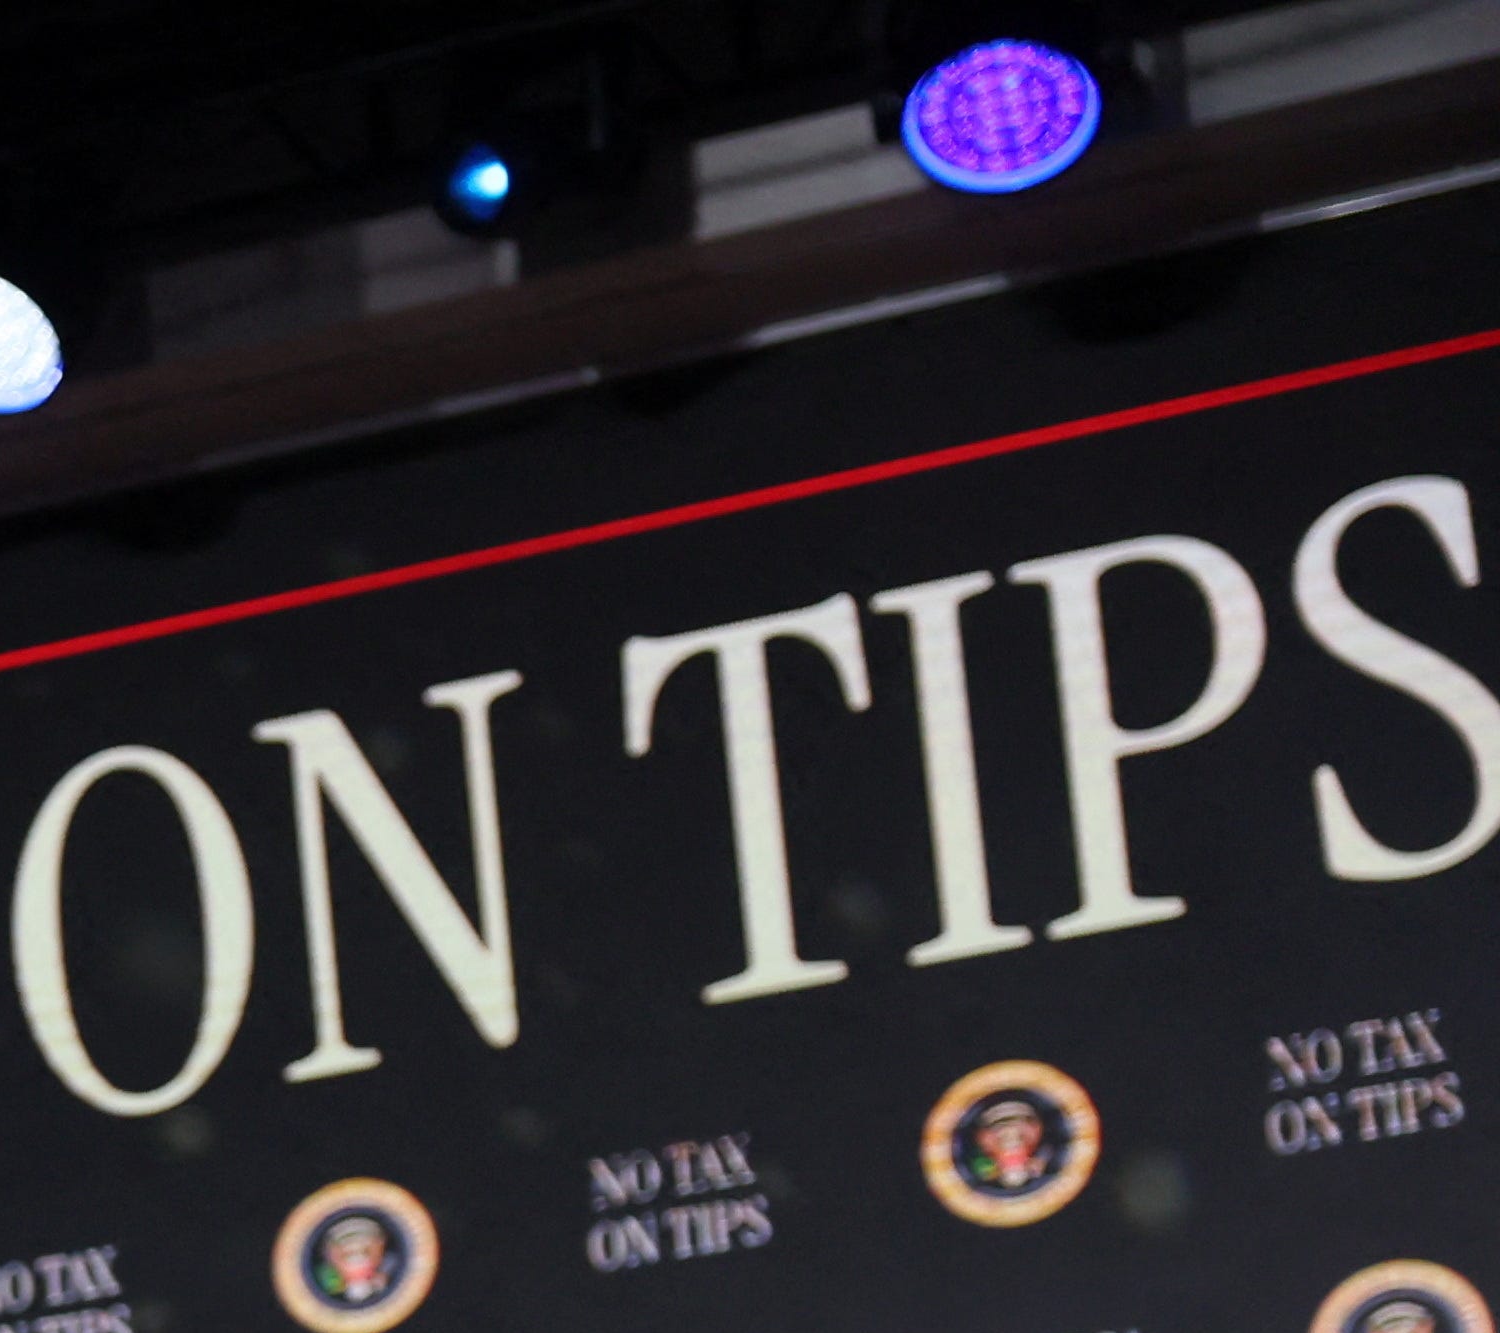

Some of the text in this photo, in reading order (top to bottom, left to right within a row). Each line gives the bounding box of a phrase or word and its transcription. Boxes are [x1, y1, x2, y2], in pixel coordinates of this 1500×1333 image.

[13, 671, 520, 1115] ON
[624, 477, 1500, 1002] TIPS
[1265, 1007, 1446, 1092] NO TAX
[1264, 1070, 1465, 1155] ON TIPS
[588, 1135, 756, 1212] NO TAX
[586, 1193, 773, 1271] ON TIPS
[34, 1245, 121, 1308] TAX
